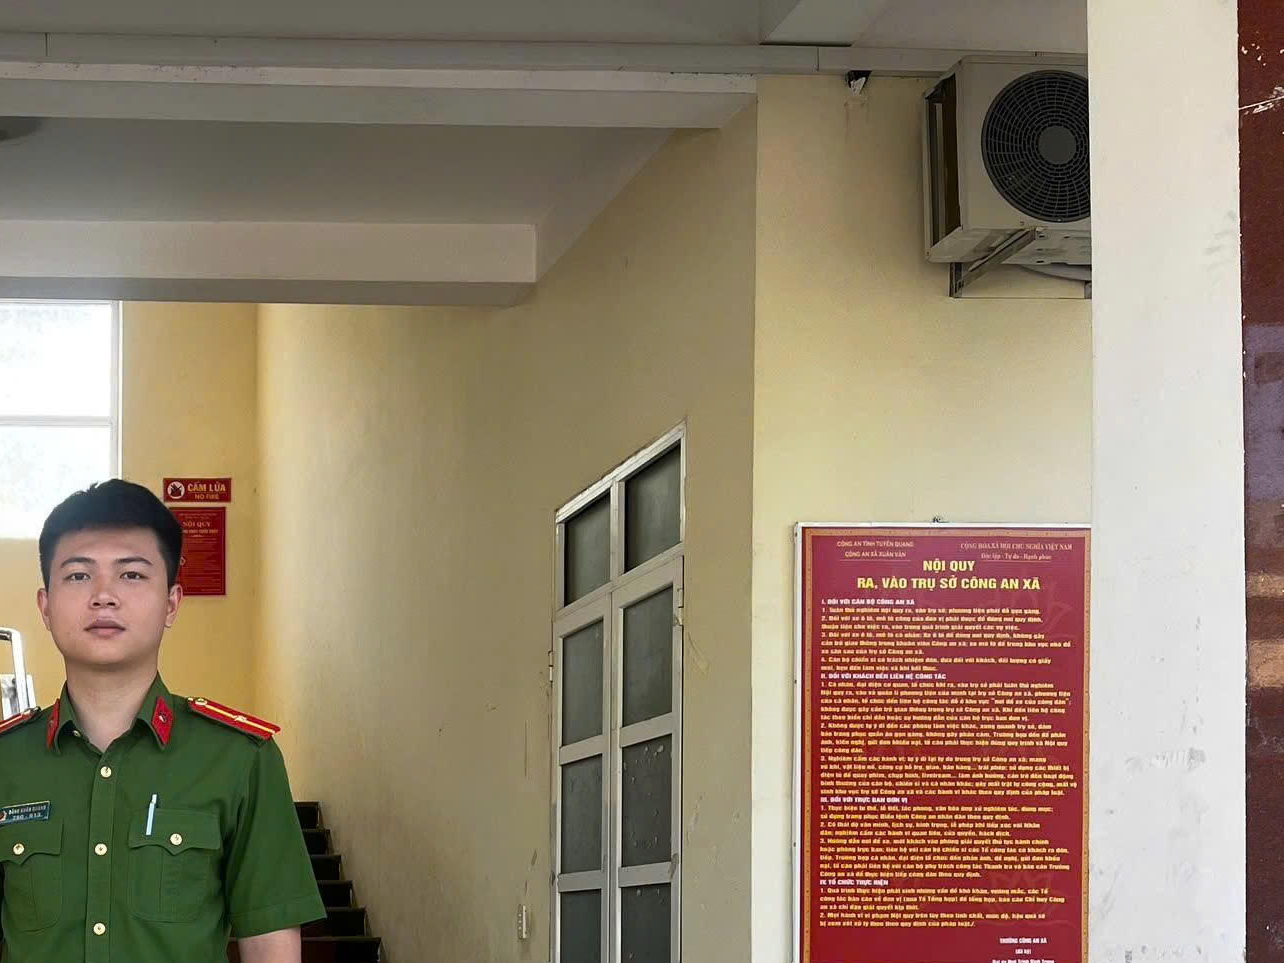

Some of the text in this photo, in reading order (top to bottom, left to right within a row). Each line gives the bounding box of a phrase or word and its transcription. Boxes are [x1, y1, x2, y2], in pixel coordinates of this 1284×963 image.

[187, 481, 226, 492] CẤM LỬA
[862, 551, 870, 559] AN
[923, 558, 975, 573] NỘI QUY
[857, 575, 1040, 592] RA, VÀO TRỤ SỞ CÔNG AN XÃ
[895, 598, 905, 606] AN
